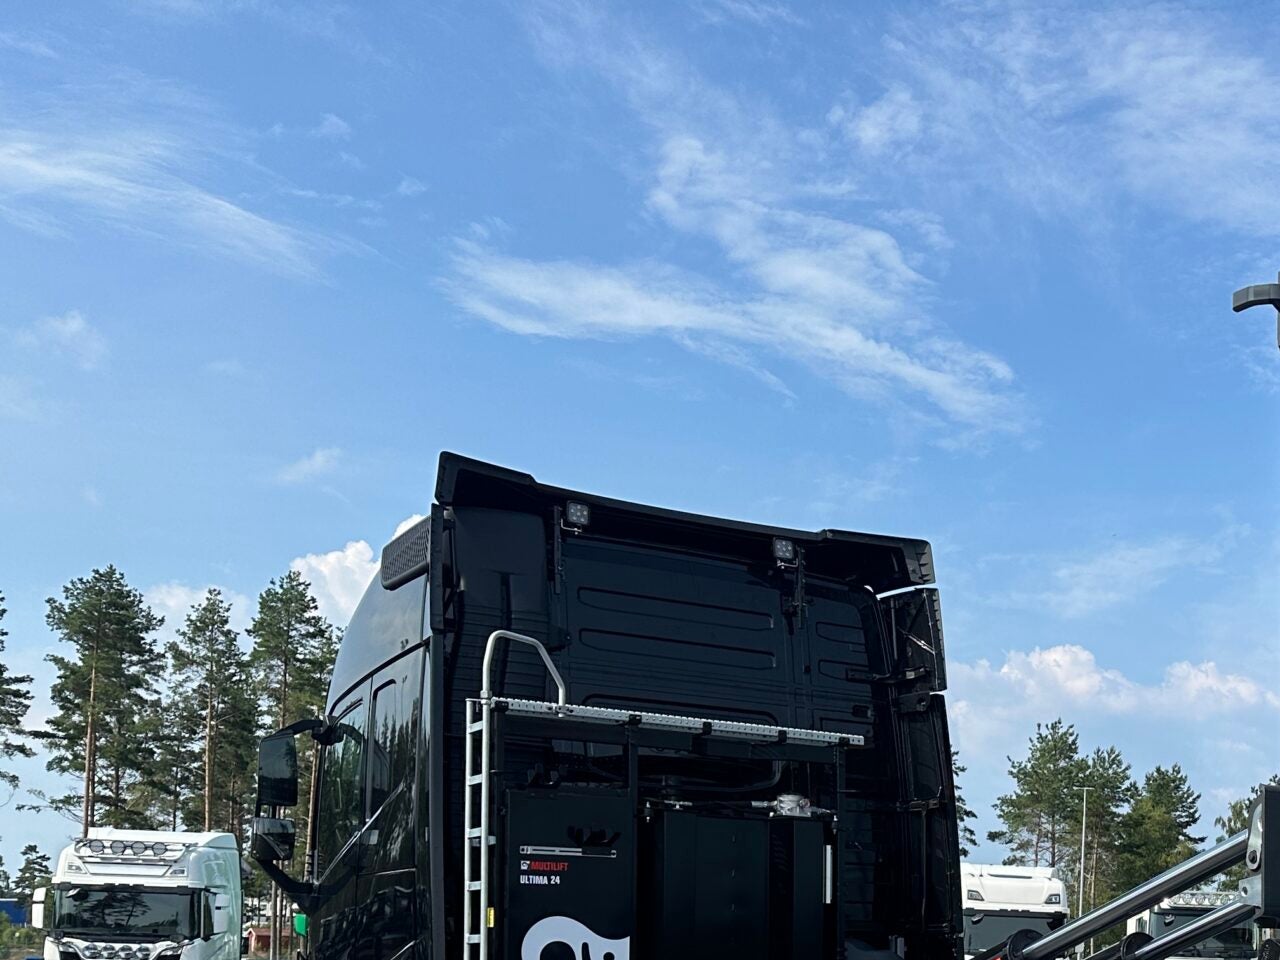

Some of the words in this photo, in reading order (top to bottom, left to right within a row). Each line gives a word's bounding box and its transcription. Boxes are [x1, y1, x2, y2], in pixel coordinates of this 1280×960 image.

[531, 862, 568, 871] MULTILIFT
[520, 875, 548, 885] ULTIMA
[550, 876, 560, 884] 24
